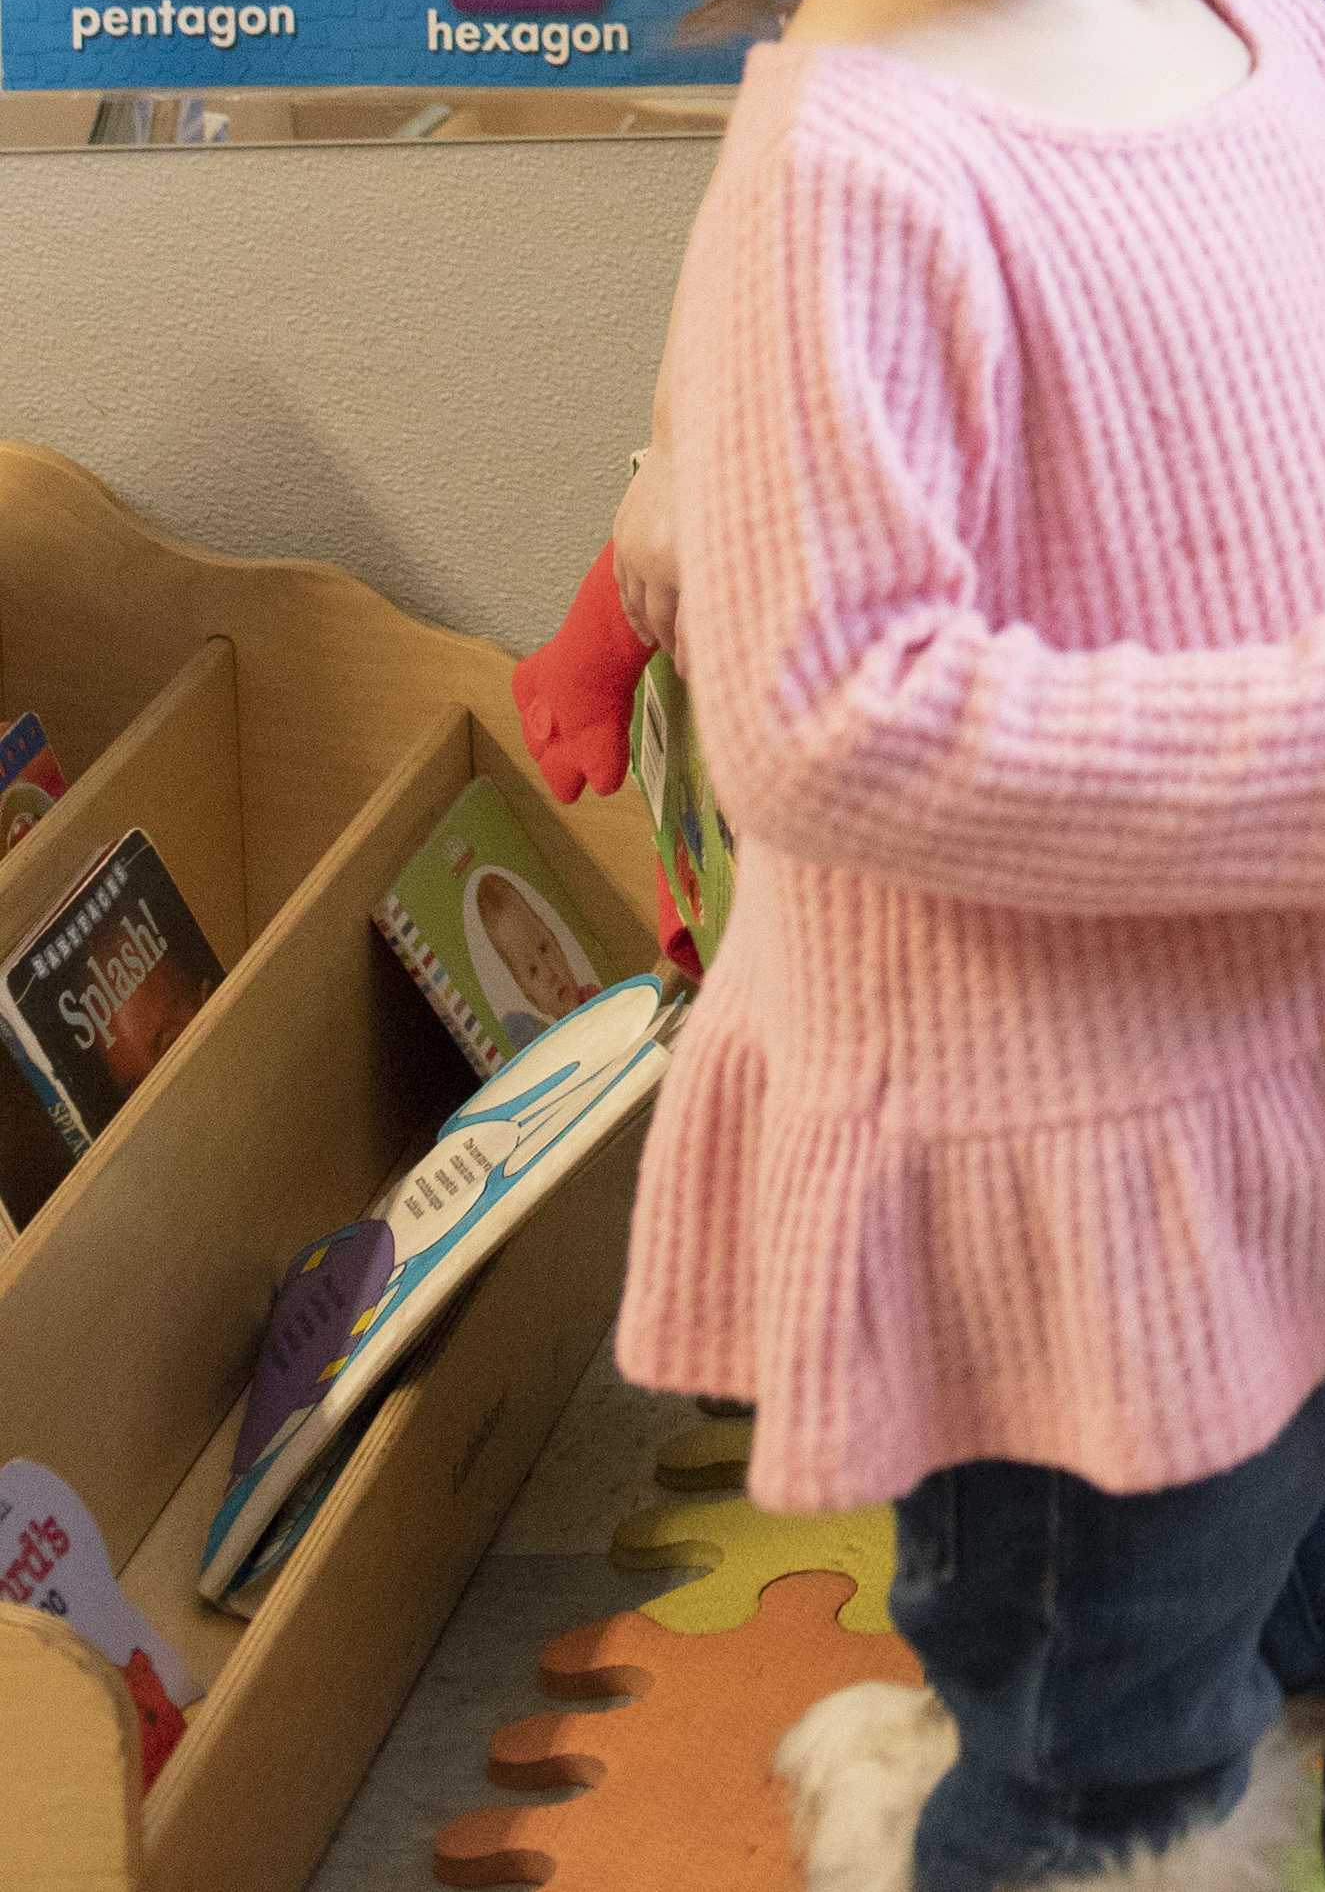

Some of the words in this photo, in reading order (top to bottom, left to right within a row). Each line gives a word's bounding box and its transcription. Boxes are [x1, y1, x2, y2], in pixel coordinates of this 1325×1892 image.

[72, 0, 295, 50] pentagon
[428, 12, 629, 64] hexagon
[58, 898, 168, 1050] Splash!
